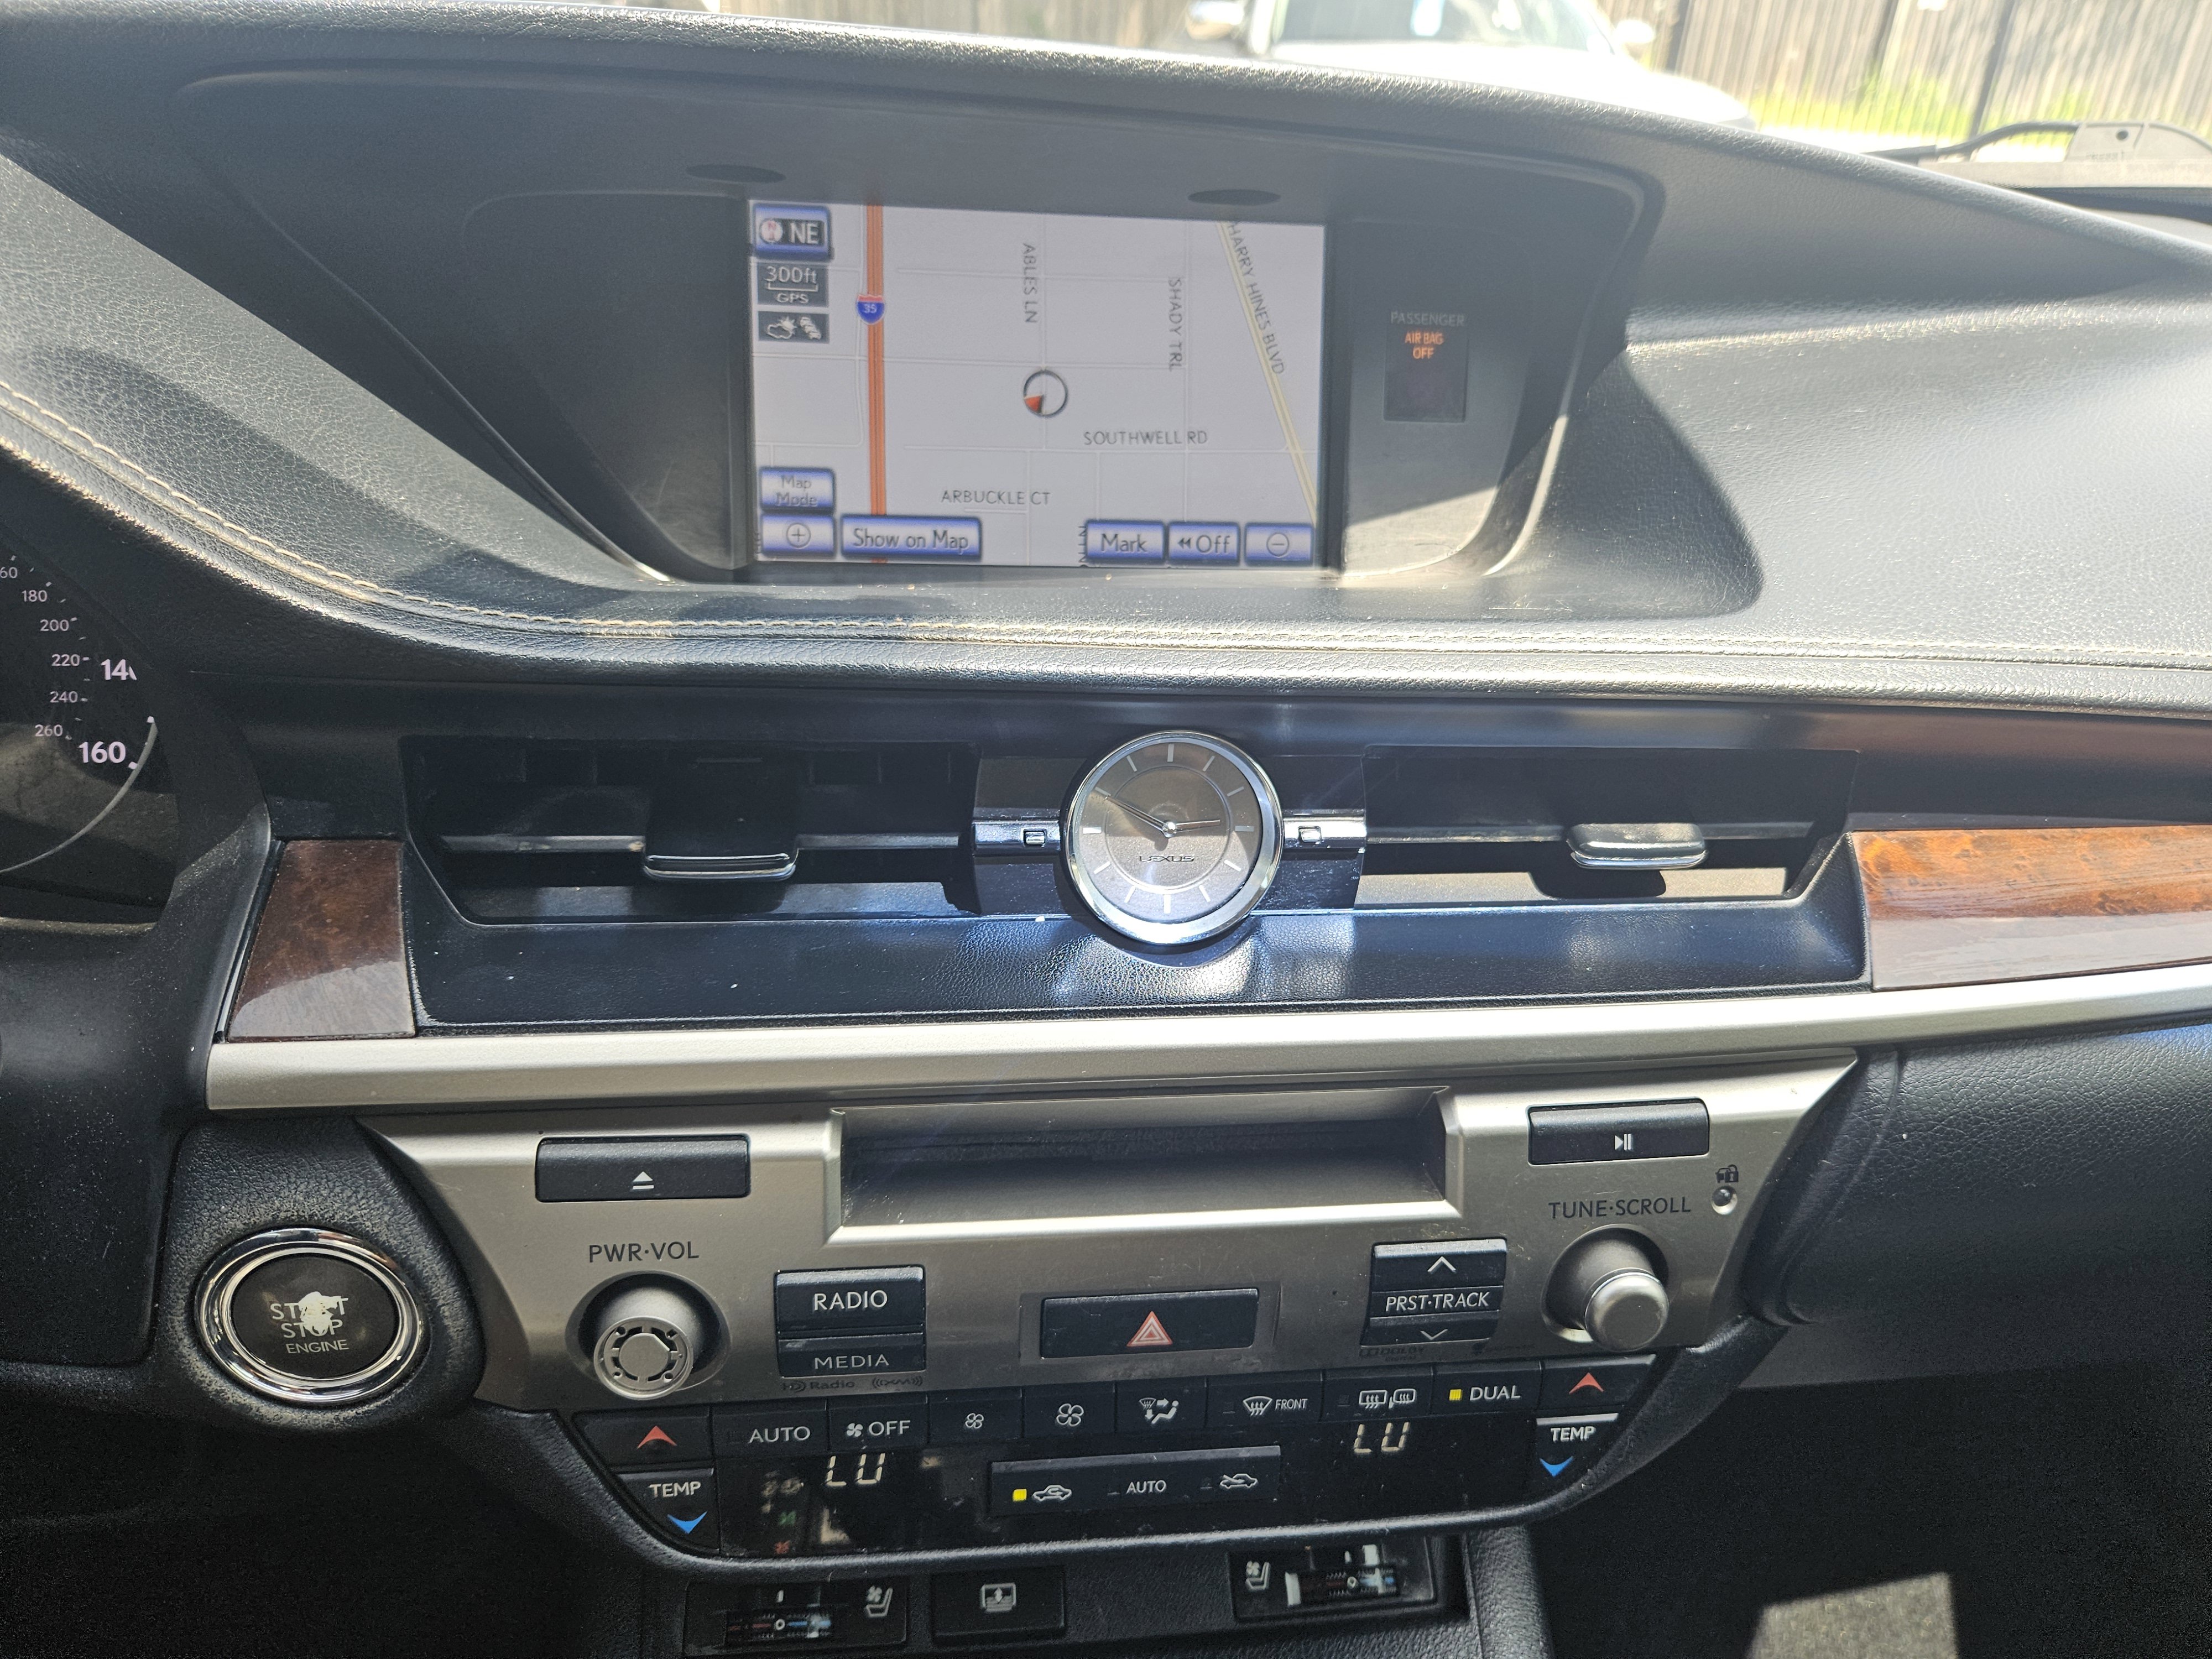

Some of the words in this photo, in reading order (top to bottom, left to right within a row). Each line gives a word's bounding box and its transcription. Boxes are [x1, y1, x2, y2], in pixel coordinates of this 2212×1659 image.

[790, 222, 818, 244] NE
[765, 265, 817, 284] 300ft
[1022, 242, 1037, 296] ABLES
[776, 293, 809, 304] GPS
[1228, 222, 1255, 277] HARRY
[1246, 281, 1272, 330] HINES
[1262, 333, 1285, 374] BLVD
[863, 304, 878, 314] 35
[1024, 301, 1038, 323] LN
[1167, 278, 1183, 336] SHADY
[1390, 311, 1466, 327] PASSENGER
[1405, 332, 1421, 343] AIR
[1423, 332, 1444, 345] BAG
[1167, 341, 1183, 371] TRL
[1412, 347, 1434, 359] OFF
[1083, 431, 1181, 445] SOUTHWELL
[1187, 431, 1208, 444] RD
[781, 475, 812, 491] Map
[776, 493, 818, 508] Mode
[941, 491, 1026, 505] ARBUCKLE
[1031, 492, 1050, 505] CT
[853, 528, 900, 549] Show
[906, 534, 926, 549] on
[932, 530, 970, 554] Map
[1100, 533, 1148, 553] Mark
[1196, 535, 1231, 554] Off
[22, 590, 48, 602] 180
[40, 619, 70, 632] 200
[51, 654, 80, 666] 220
[50, 691, 78, 703] 240
[34, 725, 63, 737] 260
[79, 741, 126, 764] 160
[814, 1290, 888, 1311] RADIO
[286, 1339, 349, 1354] ENGINE
[814, 1354, 890, 1369] MEDIA
[810, 1380, 855, 1390] Radio
[1469, 1385, 1521, 1401] DUAL
[1275, 1398, 1308, 1410] FRONT
[748, 1426, 811, 1443] AUTO
[868, 1420, 911, 1436] OFF
[1550, 1426, 1596, 1441] TEMP
[649, 1481, 702, 1498] TEMP
[1126, 1480, 1166, 1494] AUTO
